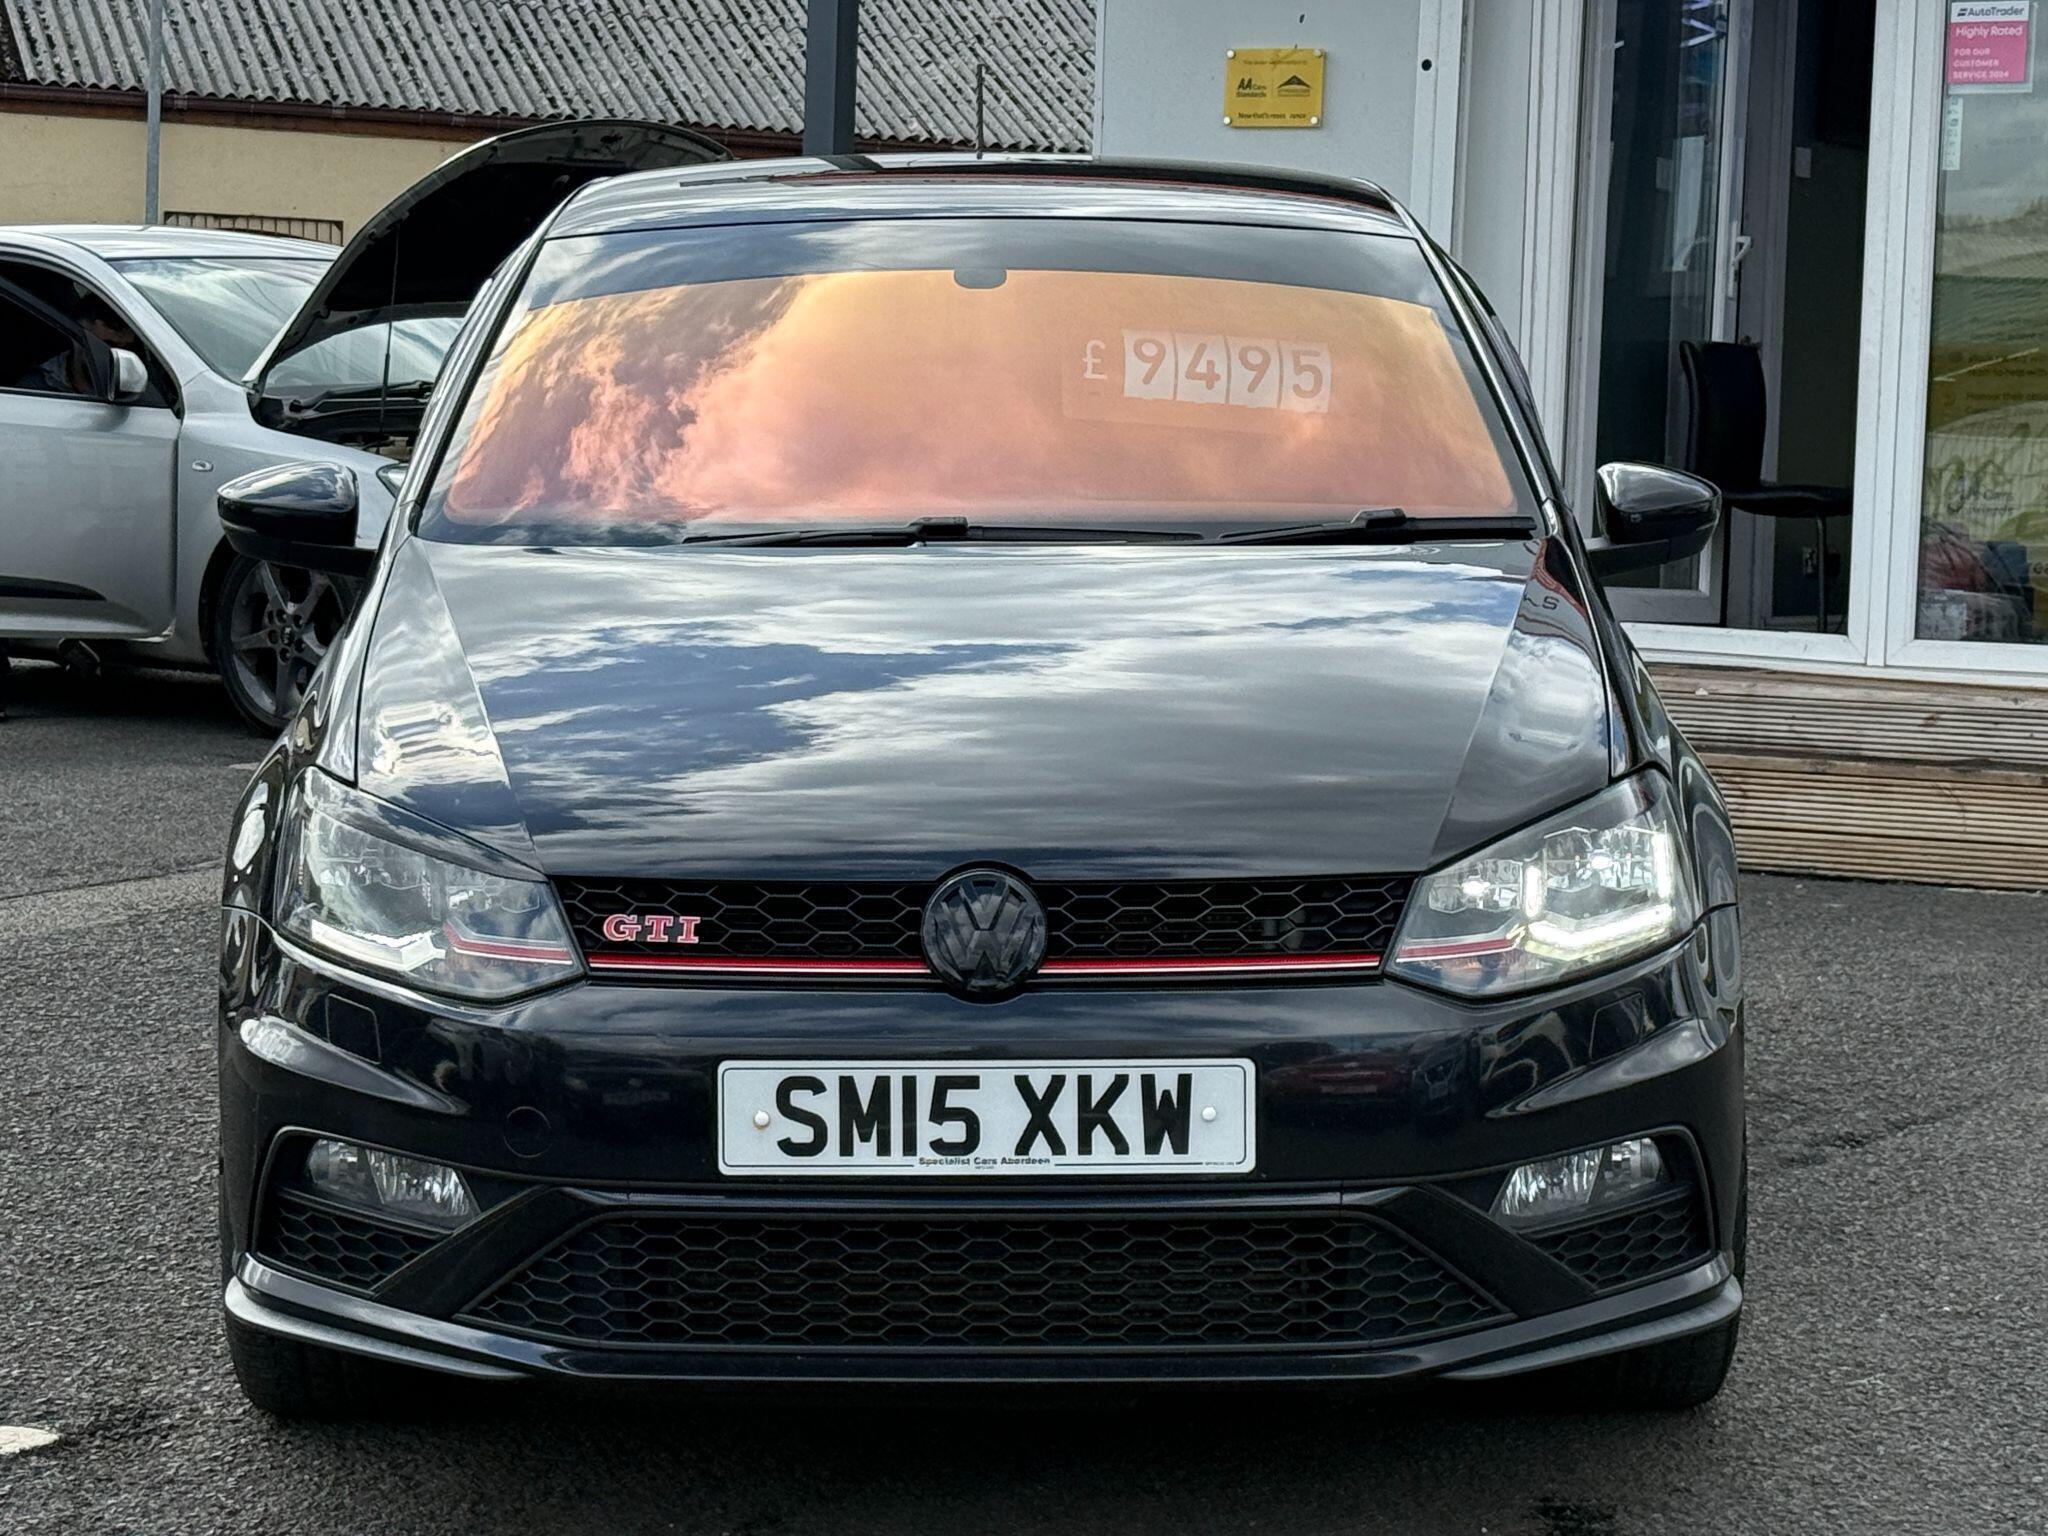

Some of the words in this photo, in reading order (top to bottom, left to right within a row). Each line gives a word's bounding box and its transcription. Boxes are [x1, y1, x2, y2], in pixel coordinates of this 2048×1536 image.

[1968, 7, 2024, 16] AutoTrader
[1956, 27, 1989, 38] Highly
[1991, 26, 2022, 35] Rated
[1953, 48, 1971, 56] FOR
[1972, 48, 1990, 56] OUR
[1952, 71, 1986, 79] SERVICE
[1238, 78, 1252, 90] AA
[603, 914, 701, 943] GTI
[775, 1075, 980, 1157] SM15
[1013, 1073, 1193, 1156] XKW
[919, 1157, 970, 1166] Specialist
[973, 1157, 997, 1165] Cars
[1000, 1157, 1050, 1165] Aberdeen
